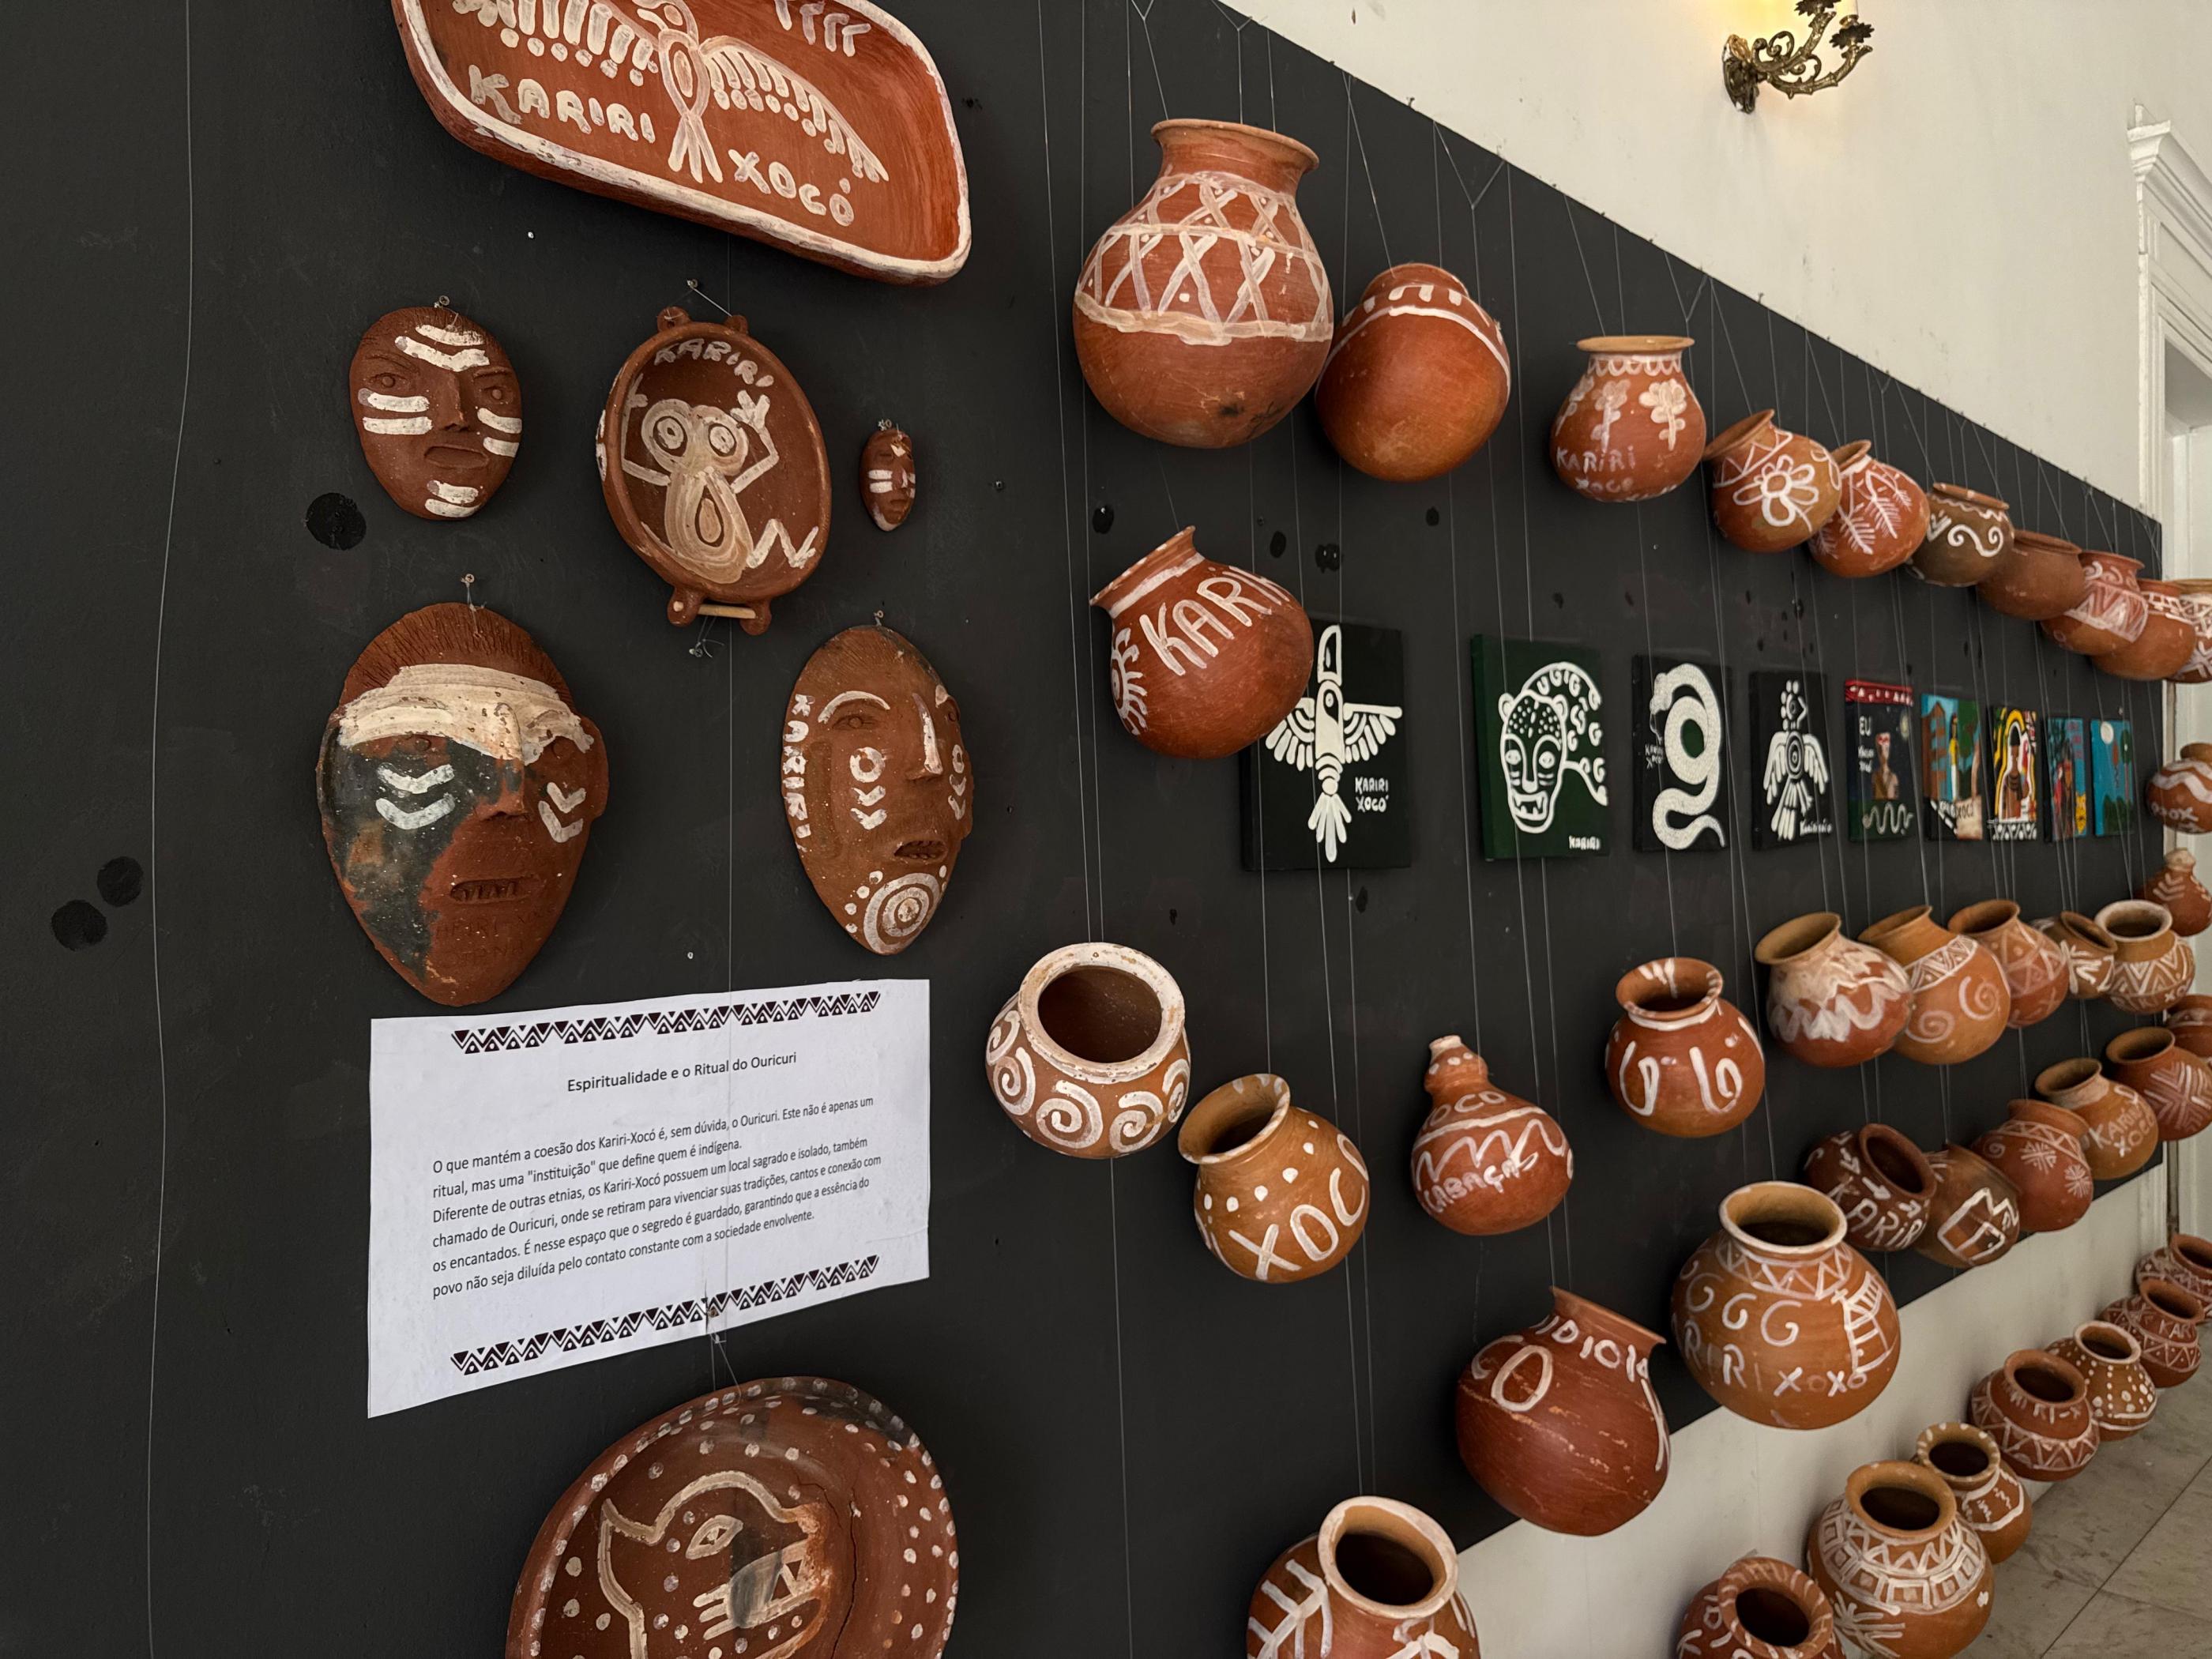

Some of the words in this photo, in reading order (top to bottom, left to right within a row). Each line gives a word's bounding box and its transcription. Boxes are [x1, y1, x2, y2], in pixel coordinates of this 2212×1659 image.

[468, 64, 656, 145] KARIRI
[654, 338, 774, 388] KARIRI
[1355, 776, 1389, 793] KARIRI
[567, 1068, 668, 1093] Espiritualidade
[671, 1070, 679, 1079] e
[682, 1068, 690, 1078] o
[694, 1059, 729, 1076] Ritual
[732, 1058, 748, 1071] do
[750, 1051, 796, 1068] Ouricuri
[433, 1160, 442, 1173] O
[446, 1159, 469, 1174] que
[472, 1149, 521, 1168] mantém
[524, 1150, 531, 1160] a
[534, 1142, 574, 1159] coesão
[576, 1139, 596, 1153] dos
[599, 1128, 656, 1149] Kariri-Xocó
[658, 1127, 668, 1141] é,
[670, 1127, 692, 1138] sem
[694, 1119, 730, 1134] dúvida,
[732, 1119, 739, 1128] o
[740, 1110, 780, 1127] Ouricuri.
[782, 1108, 801, 1120] Este
[803, 1104, 819, 1116] não
[821, 1102, 826, 1114] é
[828, 1100, 858, 1114] apenas
[860, 1097, 874, 1108] um
[433, 1180, 468, 1198] ritual,
[472, 1179, 496, 1192] mas
[498, 1175, 525, 1188] uma
[528, 1160, 596, 1183] "instituição"
[599, 1160, 619, 1174] que
[622, 1153, 655, 1168] define
[657, 1149, 687, 1164] quem
[690, 1144, 697, 1157] é
[698, 1140, 742, 1156] indígena.
[433, 1204, 488, 1223] Diferente
[491, 1199, 506, 1213] de
[509, 1194, 546, 1210] outras
[548, 1188, 585, 1203] etnias,
[588, 1186, 600, 1197] os
[604, 1172, 660, 1194] Kariri-Xocó
[664, 1168, 708, 1187] possuem
[711, 1164, 726, 1176] um
[728, 1157, 750, 1172] local
[752, 1151, 788, 1168] sagrado
[790, 1152, 796, 1161] e
[798, 1144, 831, 1159] isolado,
[833, 1138, 867, 1153] também
[433, 1226, 488, 1247] chamado
[491, 1223, 506, 1237] de
[509, 1213, 558, 1234] Ouricuri,
[561, 1209, 589, 1224] onde
[592, 1208, 604, 1219] se
[607, 1201, 645, 1217] retiram
[649, 1196, 672, 1212] para
[674, 1187, 719, 1204] vivenciar
[720, 1183, 742, 1196] suas
[743, 1174, 788, 1191] tradições,
[789, 1168, 818, 1182] cantos
[820, 1167, 826, 1176] e
[828, 1158, 863, 1174] conexão
[863, 1157, 881, 1168] com
[433, 1261, 447, 1272] os
[450, 1247, 521, 1270] encantados.
[524, 1239, 531, 1255] É
[534, 1239, 566, 1253] nesse
[568, 1231, 607, 1247] espaço
[609, 1226, 630, 1241] que
[632, 1224, 639, 1234] o
[641, 1214, 683, 1233] segredo
[686, 1211, 692, 1224] é
[694, 1203, 743, 1225] guardado,
[744, 1192, 793, 1215] garantindo
[795, 1191, 812, 1204] que
[814, 1189, 819, 1198] a
[822, 1179, 858, 1196] essência
[859, 1177, 869, 1188] do
[433, 1282, 463, 1300] povo
[466, 1275, 488, 1291] não
[491, 1270, 514, 1286] seja
[517, 1262, 555, 1280] diluída
[558, 1256, 583, 1275] pelo
[585, 1249, 626, 1266] contato
[629, 1239, 679, 1258] constante
[682, 1235, 703, 1247] com
[706, 1232, 712, 1242] a
[714, 1220, 762, 1240] sociedade
[763, 1211, 814, 1229] envolvente.
